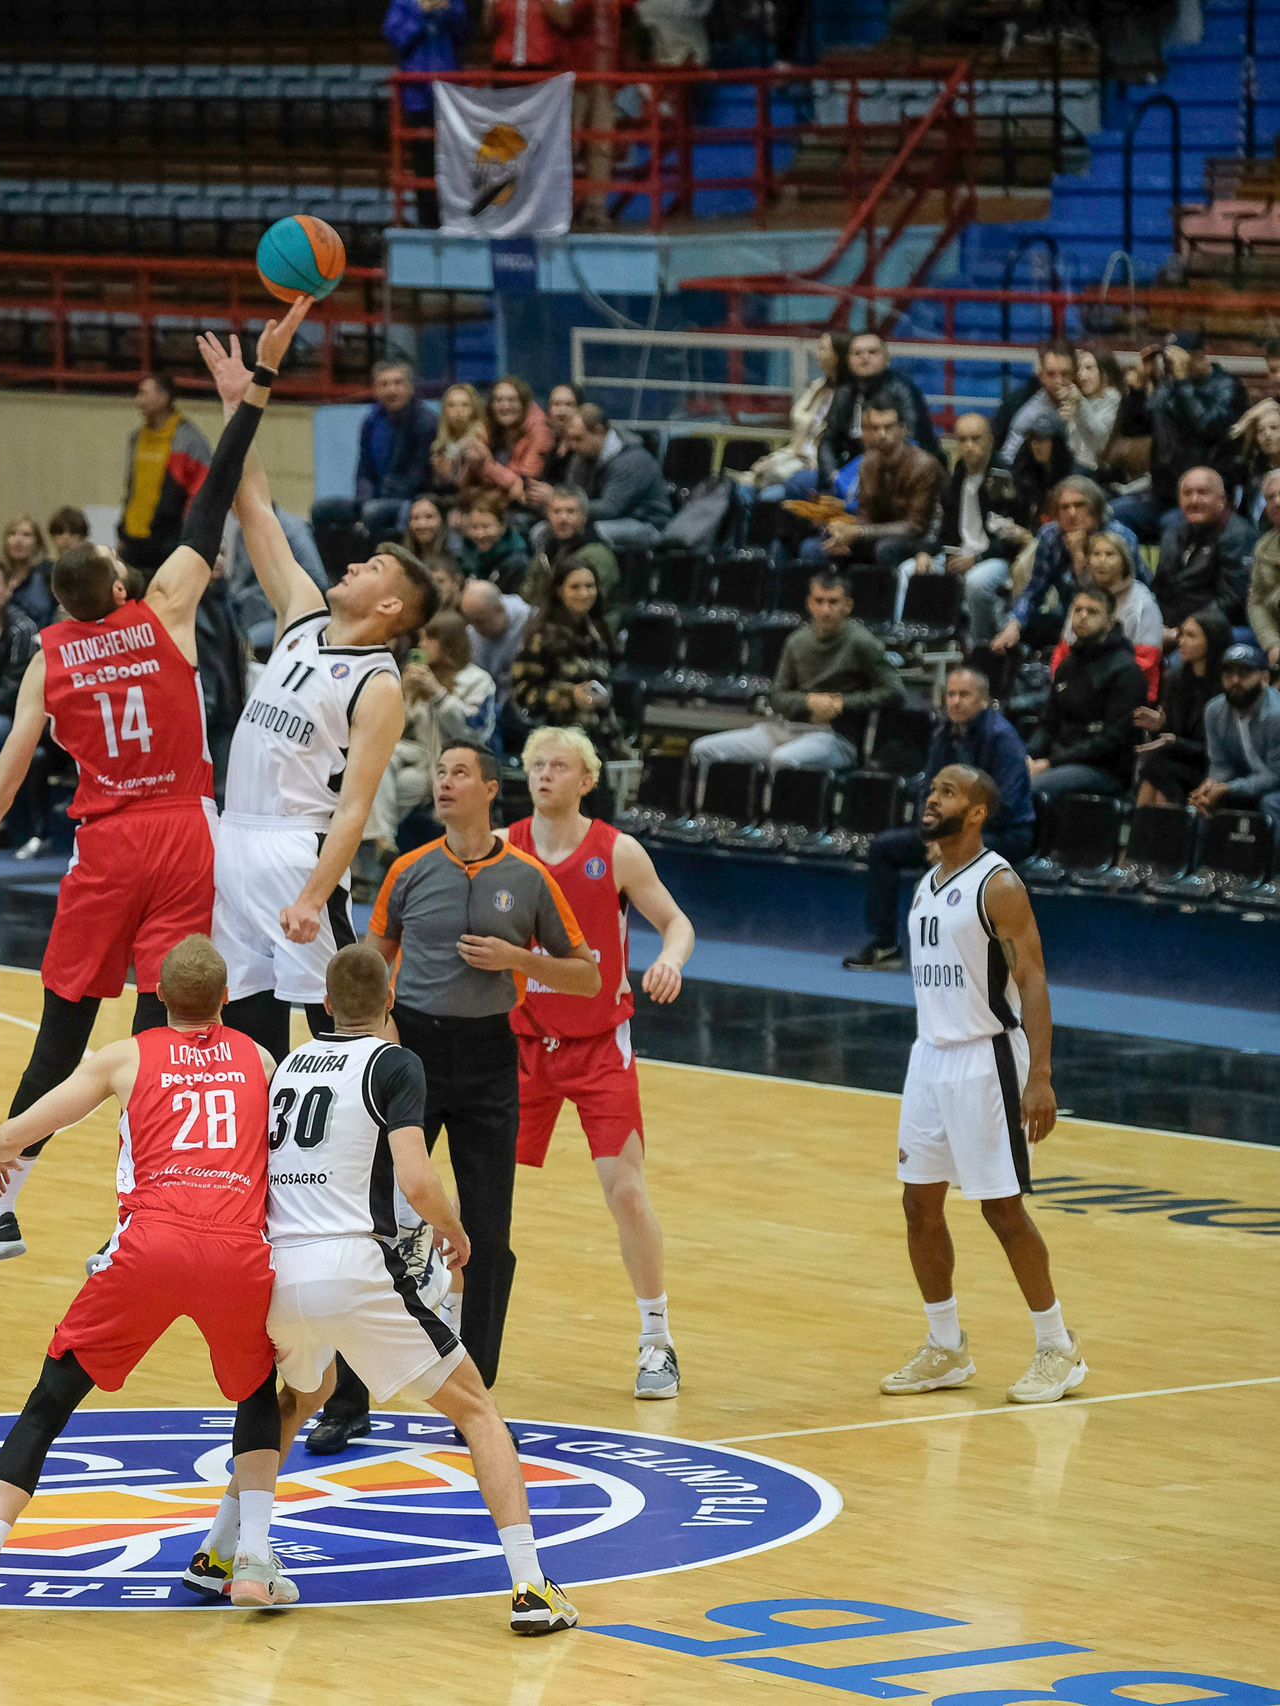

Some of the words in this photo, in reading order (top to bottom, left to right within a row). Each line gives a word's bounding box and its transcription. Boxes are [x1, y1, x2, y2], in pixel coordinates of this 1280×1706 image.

[59, 622, 156, 668] MINCHENKO
[71, 659, 160, 689] BetBoom
[281, 661, 317, 692] 11
[93, 685, 153, 758] 14
[919, 916, 939, 947] 10
[286, 1053, 349, 1074] MAVRA
[172, 1089, 237, 1150] 28
[270, 1085, 336, 1152] 30
[555, 1440, 759, 1493] UNITED
[680, 1496, 769, 1528] VTB
